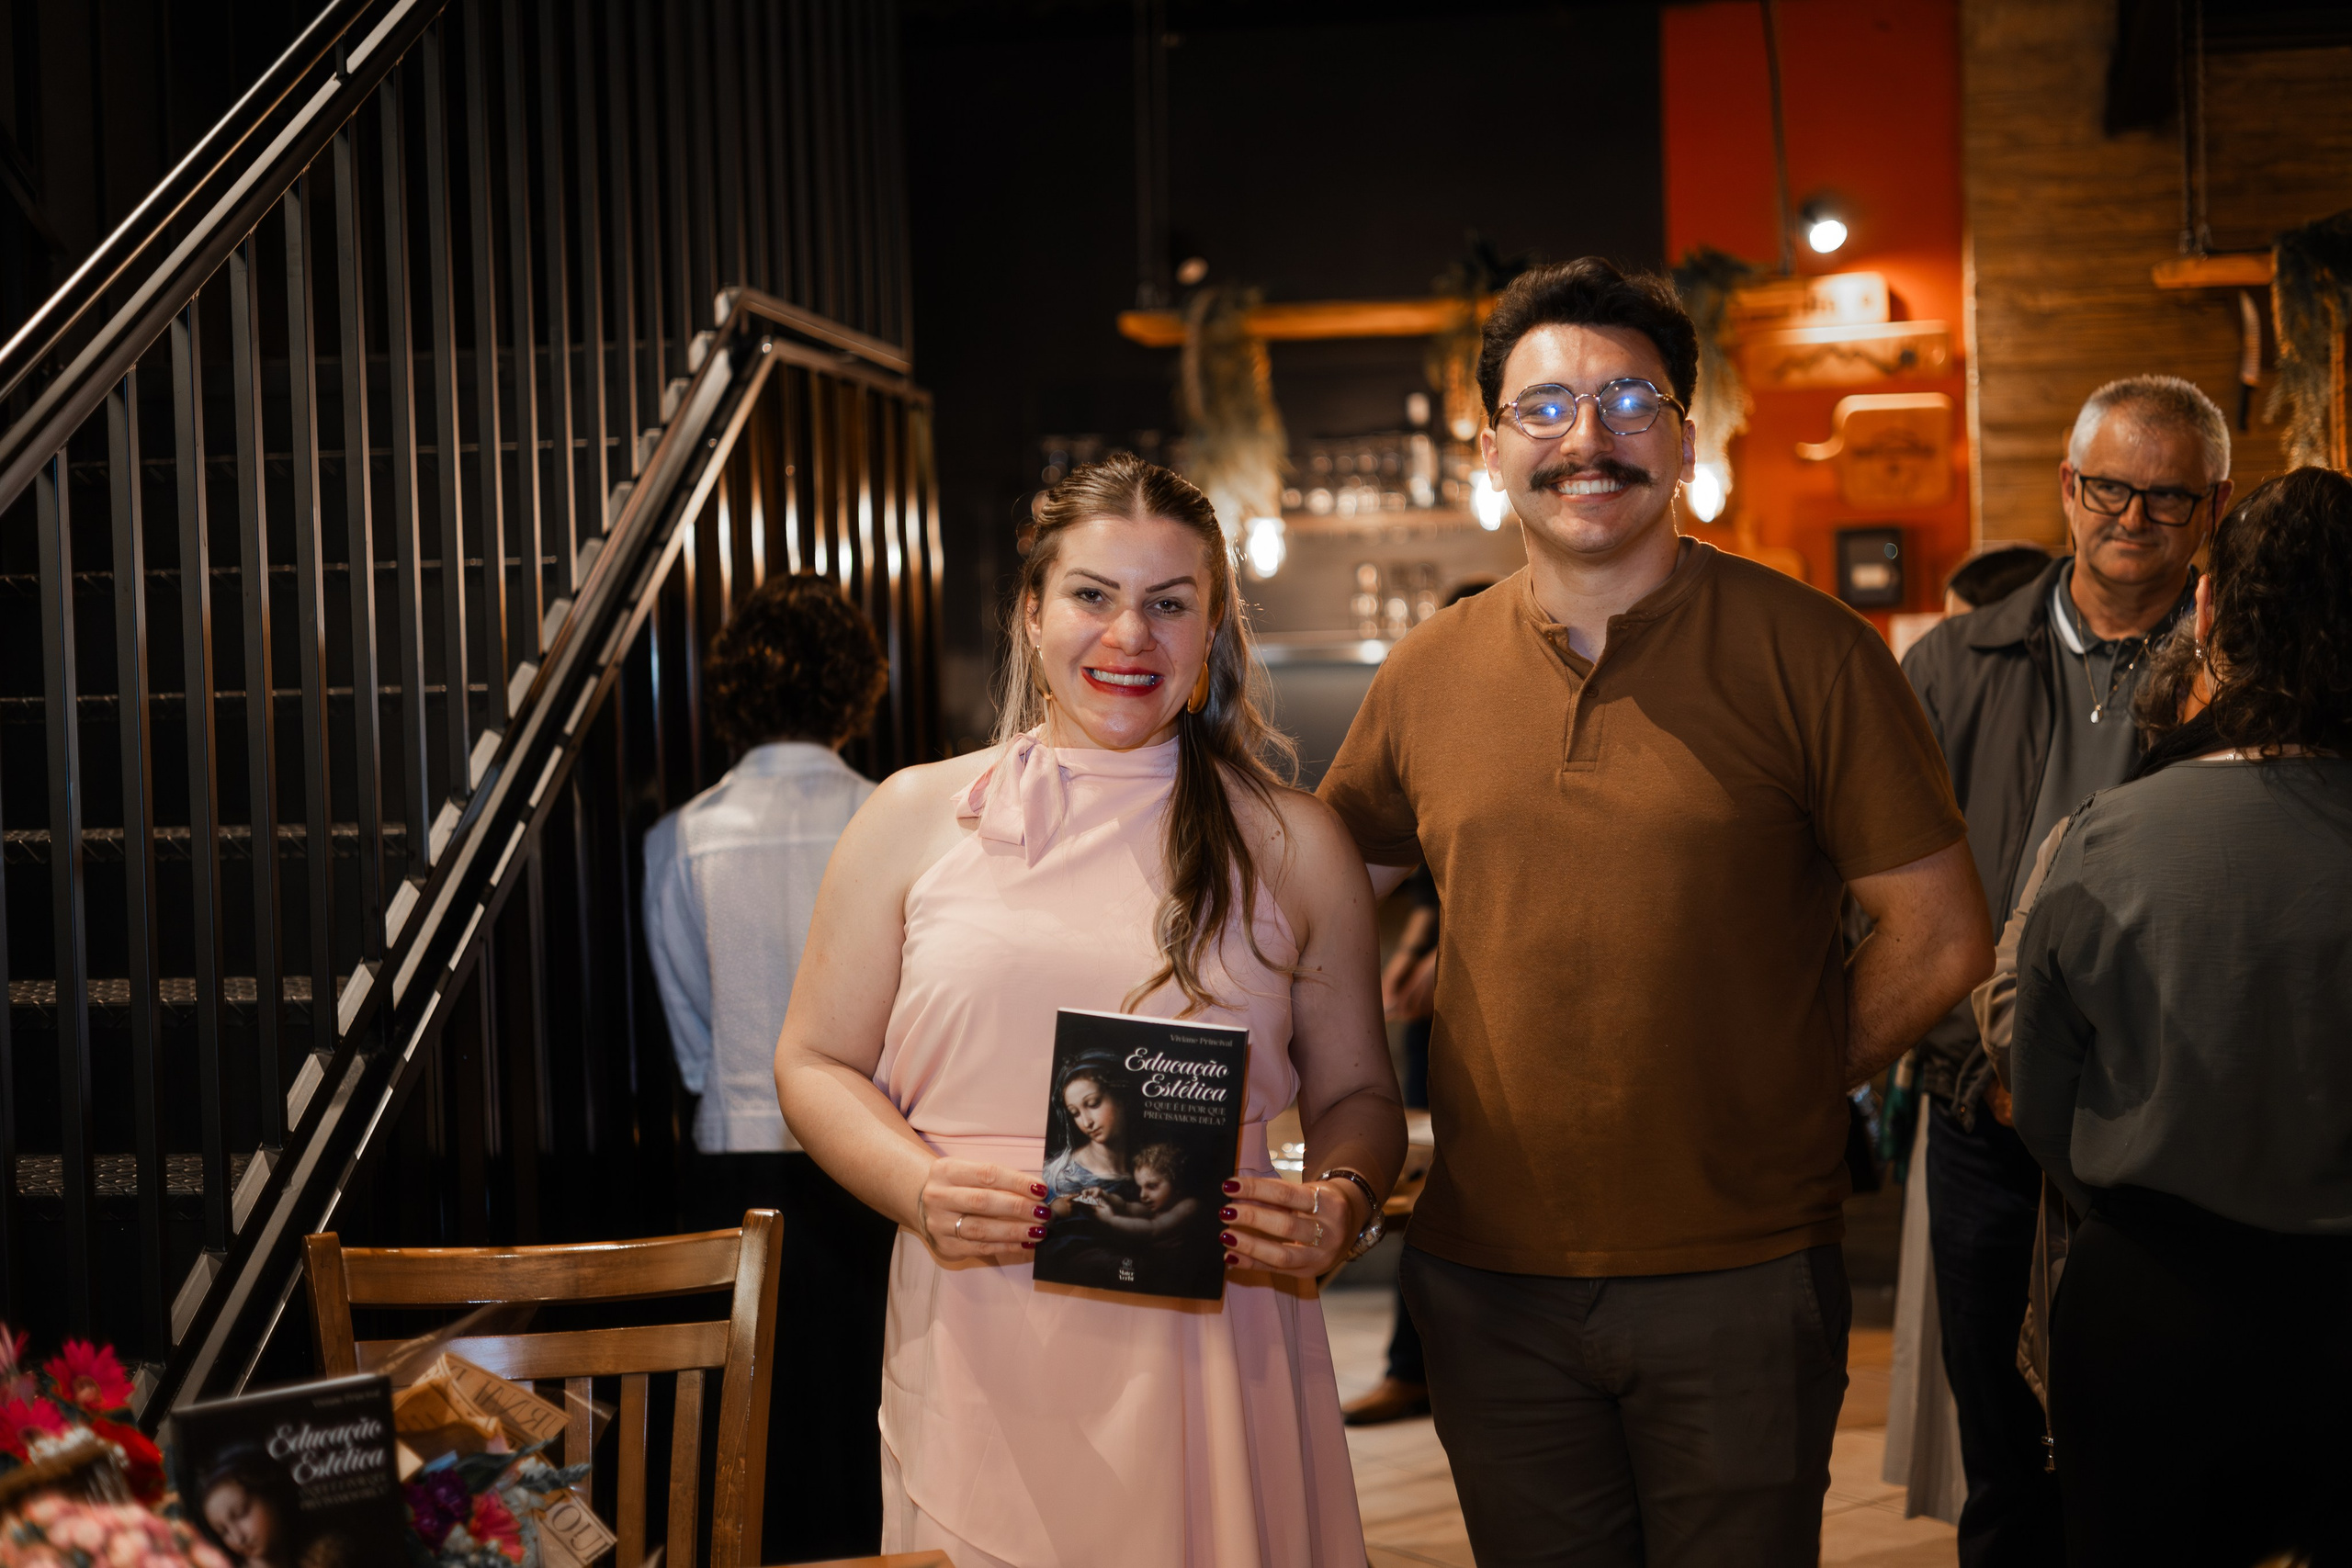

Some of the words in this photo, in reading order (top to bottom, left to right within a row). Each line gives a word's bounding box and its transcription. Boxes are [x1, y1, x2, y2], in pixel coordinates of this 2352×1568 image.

[1125, 1047, 1229, 1081] Educação
[1142, 1073, 1227, 1102] Estética
[1143, 1111, 1198, 1123] PRECISAMOS
[1199, 1116, 1227, 1127] DELA?
[1145, 1100, 1152, 1109] O
[1153, 1101, 1171, 1111] QUE
[1173, 1101, 1179, 1111] É
[1181, 1104, 1186, 1112] E
[1188, 1105, 1206, 1114] POR
[1207, 1107, 1226, 1117] QUE
[267, 1417, 381, 1460] Educação
[292, 1447, 384, 1484] Estética
